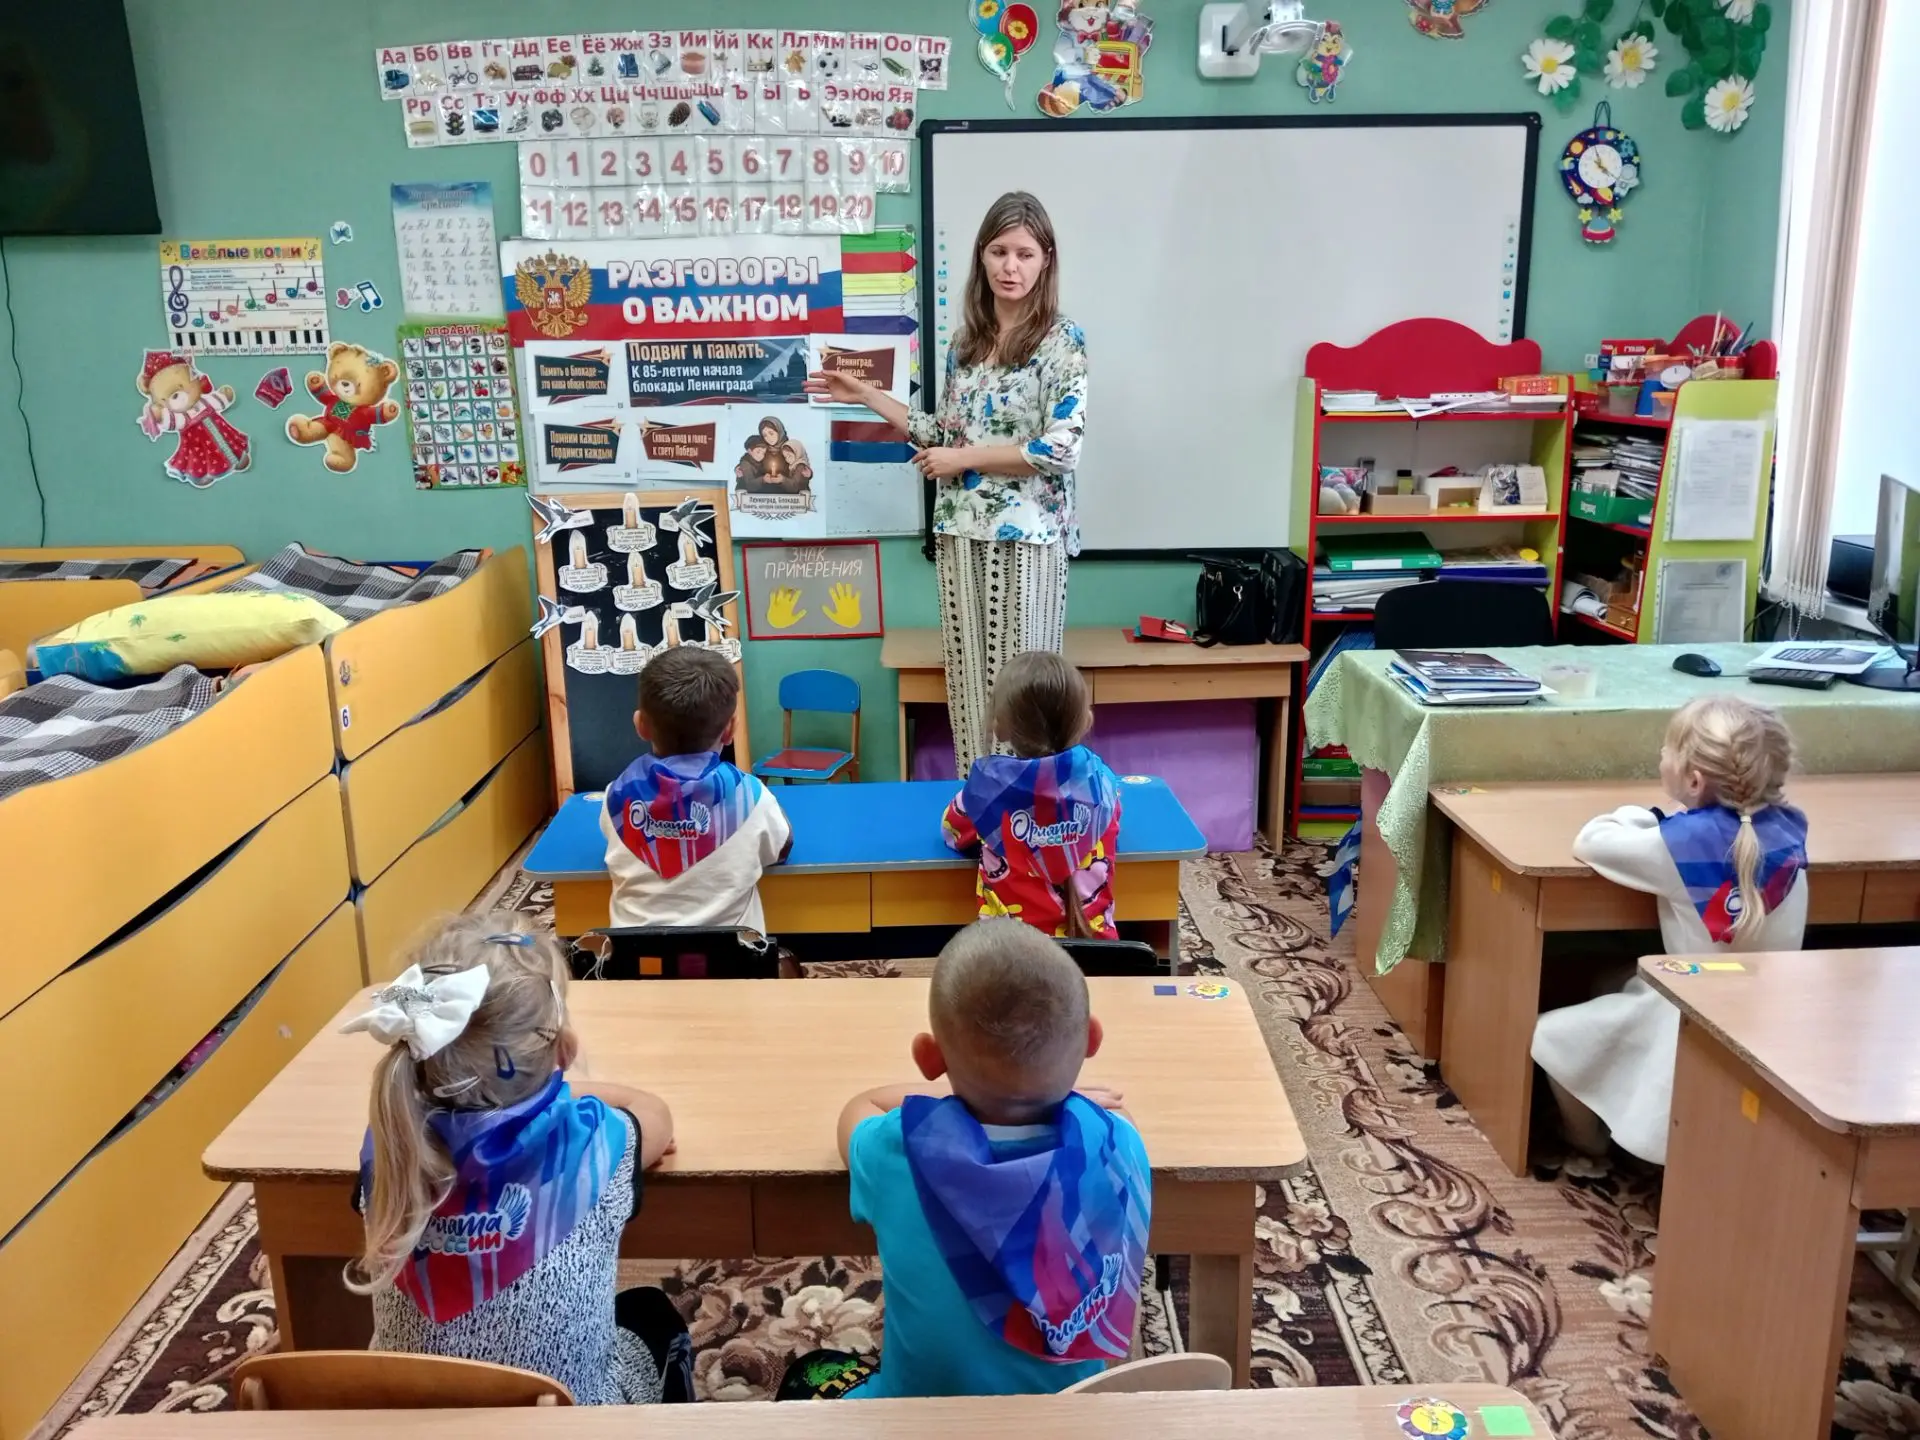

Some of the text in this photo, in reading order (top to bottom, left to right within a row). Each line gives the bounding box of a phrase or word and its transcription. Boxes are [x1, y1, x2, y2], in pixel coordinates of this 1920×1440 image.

[382, 50, 406, 65] Аа
[413, 45, 438, 62] Бб
[447, 44, 473, 59] Вв
[512, 40, 540, 58] Дд
[547, 38, 571, 53] Ее
[583, 35, 605, 54] Ёё
[610, 38, 643, 51] Жж
[648, 33, 671, 48] Зз
[680, 32, 707, 47] Ии
[714, 31, 739, 49] Йй
[747, 34, 773, 49] Кк
[781, 33, 808, 48] Лл
[813, 33, 844, 49] Мм
[850, 35, 878, 50] Нн
[884, 36, 912, 53] Оо
[918, 38, 946, 54] Пп
[407, 100, 431, 116] Рр
[441, 96, 465, 111] Сс
[505, 91, 530, 108] Уу
[534, 90, 566, 106] Фф
[572, 89, 596, 103] Хх
[601, 87, 629, 104] Цц
[633, 86, 657, 101] Чч
[732, 86, 748, 100] Ъ
[763, 86, 780, 100] Ы
[798, 87, 810, 100] Ь
[824, 86, 848, 100] Ээ
[852, 88, 884, 102] Юю
[888, 88, 913, 104] Яя
[529, 149, 904, 177] 0 1 2 3 4 5 6 7 8 9 10
[527, 194, 873, 226] 11 12 13 14 15 16 17 18 19 20
[180, 244, 302, 260] Весёлые нотки
[606, 256, 820, 289] РАЗГОВОРЫ
[622, 293, 808, 324] О ВАЖНОМ
[424, 325, 481, 337] АЛФАВИТ
[629, 341, 769, 364] Подвиг и память.
[540, 365, 564, 376] Память
[836, 356, 874, 368] Ленинград.
[631, 364, 743, 379] К 85-летию начала
[586, 380, 606, 389] совесть
[633, 378, 754, 394] блокады Ленинграда
[550, 431, 578, 443] Помним
[652, 432, 670, 443] Сквозь
[551, 445, 583, 459] Гордимся
[658, 447, 674, 458] свету
[675, 445, 698, 456] Победы
[790, 548, 826, 562] ЗНАК
[764, 559, 863, 579] ПРИМЕРЕНИЯ
[342, 708, 349, 727] 6
[630, 800, 696, 837] Орлята
[1012, 810, 1079, 846] Орлята
[421, 1214, 503, 1238] рлята
